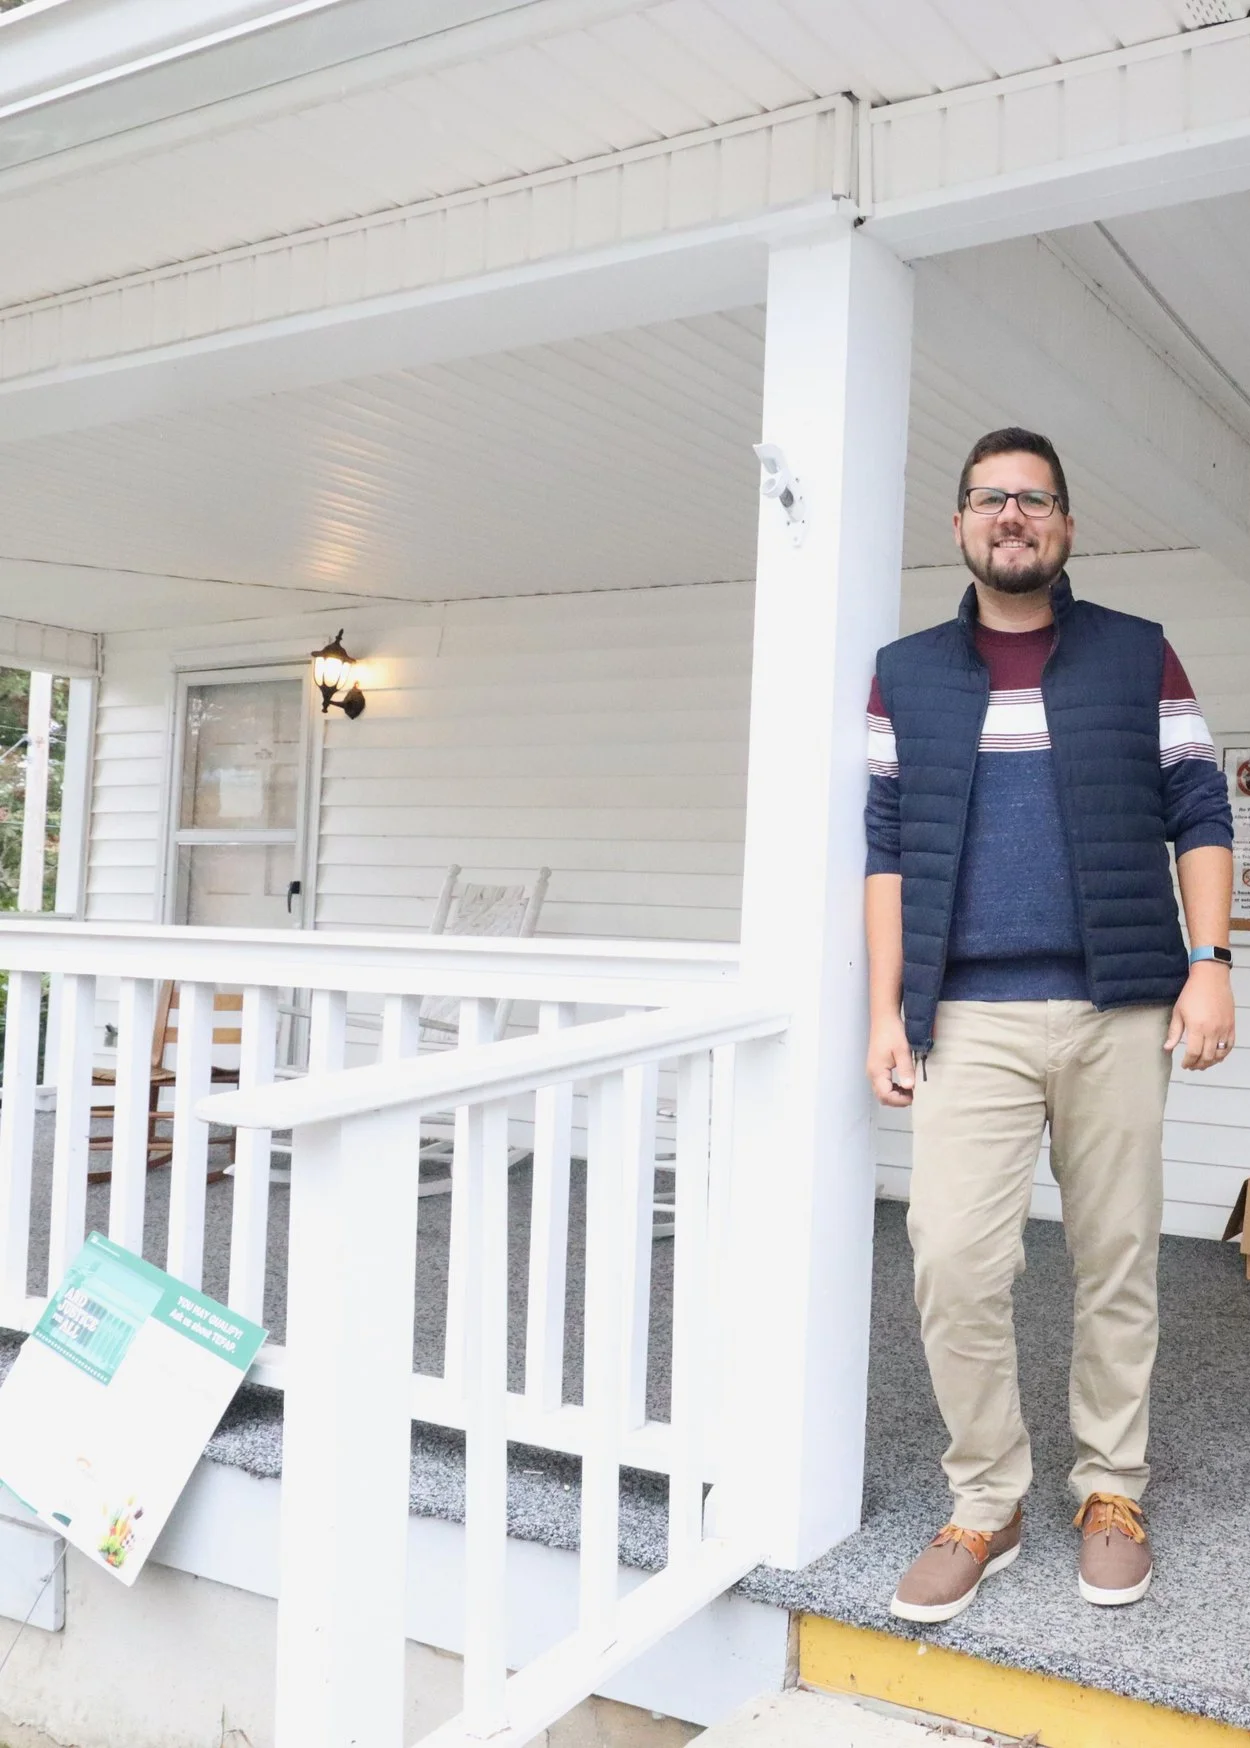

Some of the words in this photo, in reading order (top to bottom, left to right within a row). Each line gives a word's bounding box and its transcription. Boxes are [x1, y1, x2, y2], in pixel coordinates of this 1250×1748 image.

[56, 1300, 98, 1332] JUSTICE
[177, 1296, 194, 1312] YOU
[191, 1302, 211, 1321] MAY
